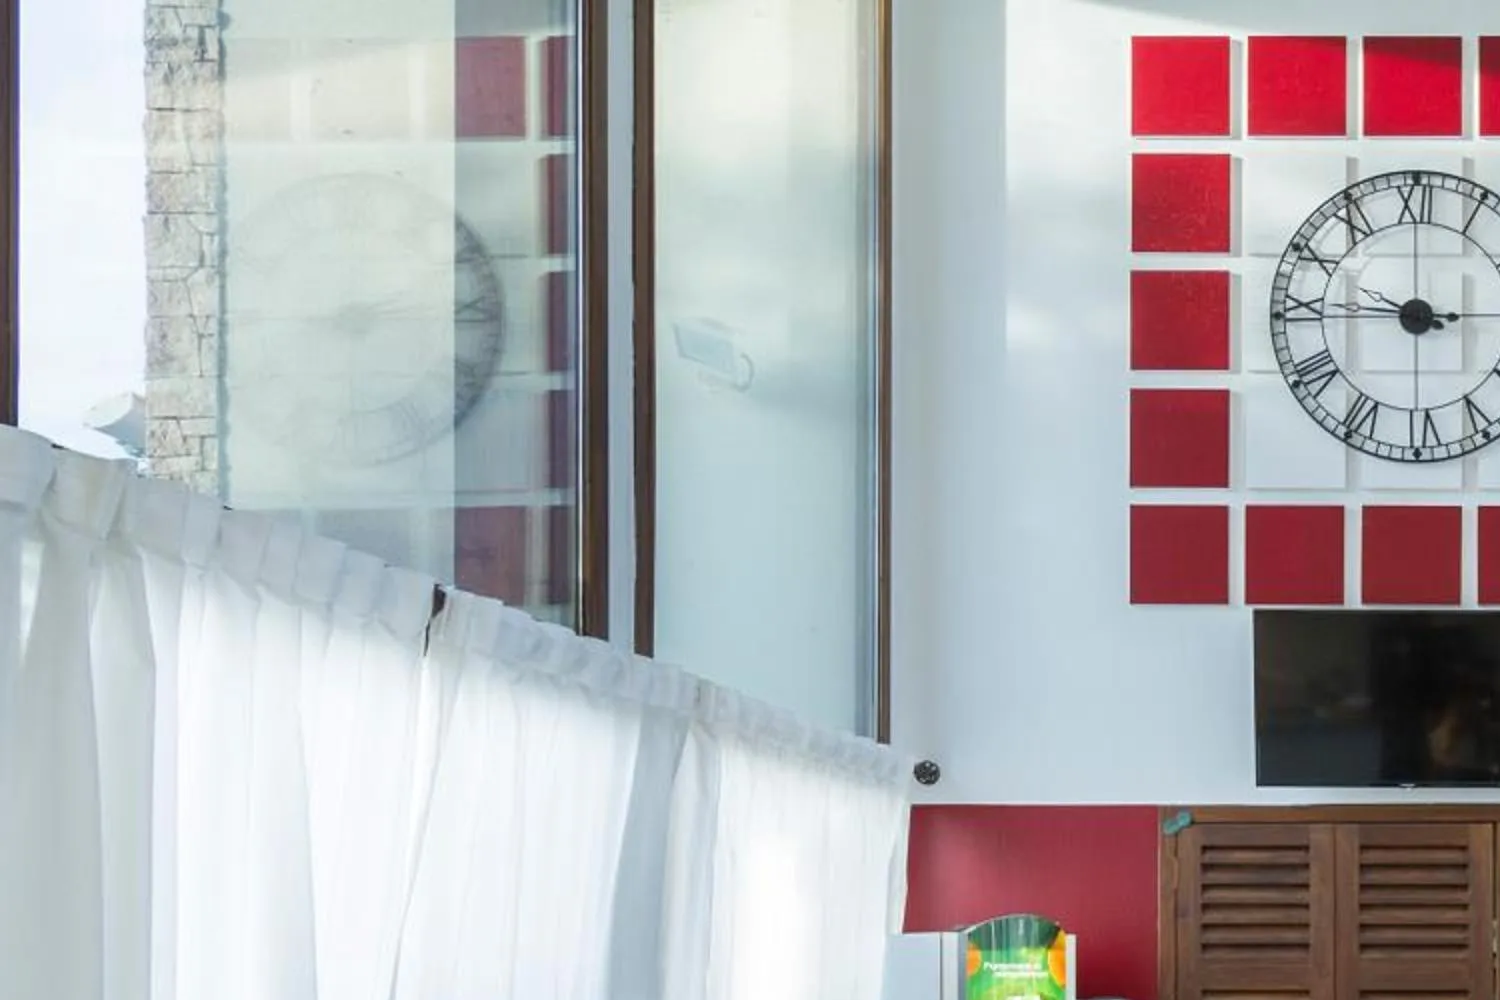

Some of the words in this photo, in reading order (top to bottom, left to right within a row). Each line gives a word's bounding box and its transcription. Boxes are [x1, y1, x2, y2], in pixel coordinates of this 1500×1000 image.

[1332, 199, 1373, 246] XI
[1398, 185, 1433, 224] XII
[1463, 201, 1483, 234] I
[1297, 245, 1339, 277] X
[1284, 293, 1324, 323] IX
[1294, 349, 1339, 398] VIII
[1342, 393, 1379, 440] VII
[1408, 408, 1441, 447] VI
[1464, 395, 1492, 434] V
